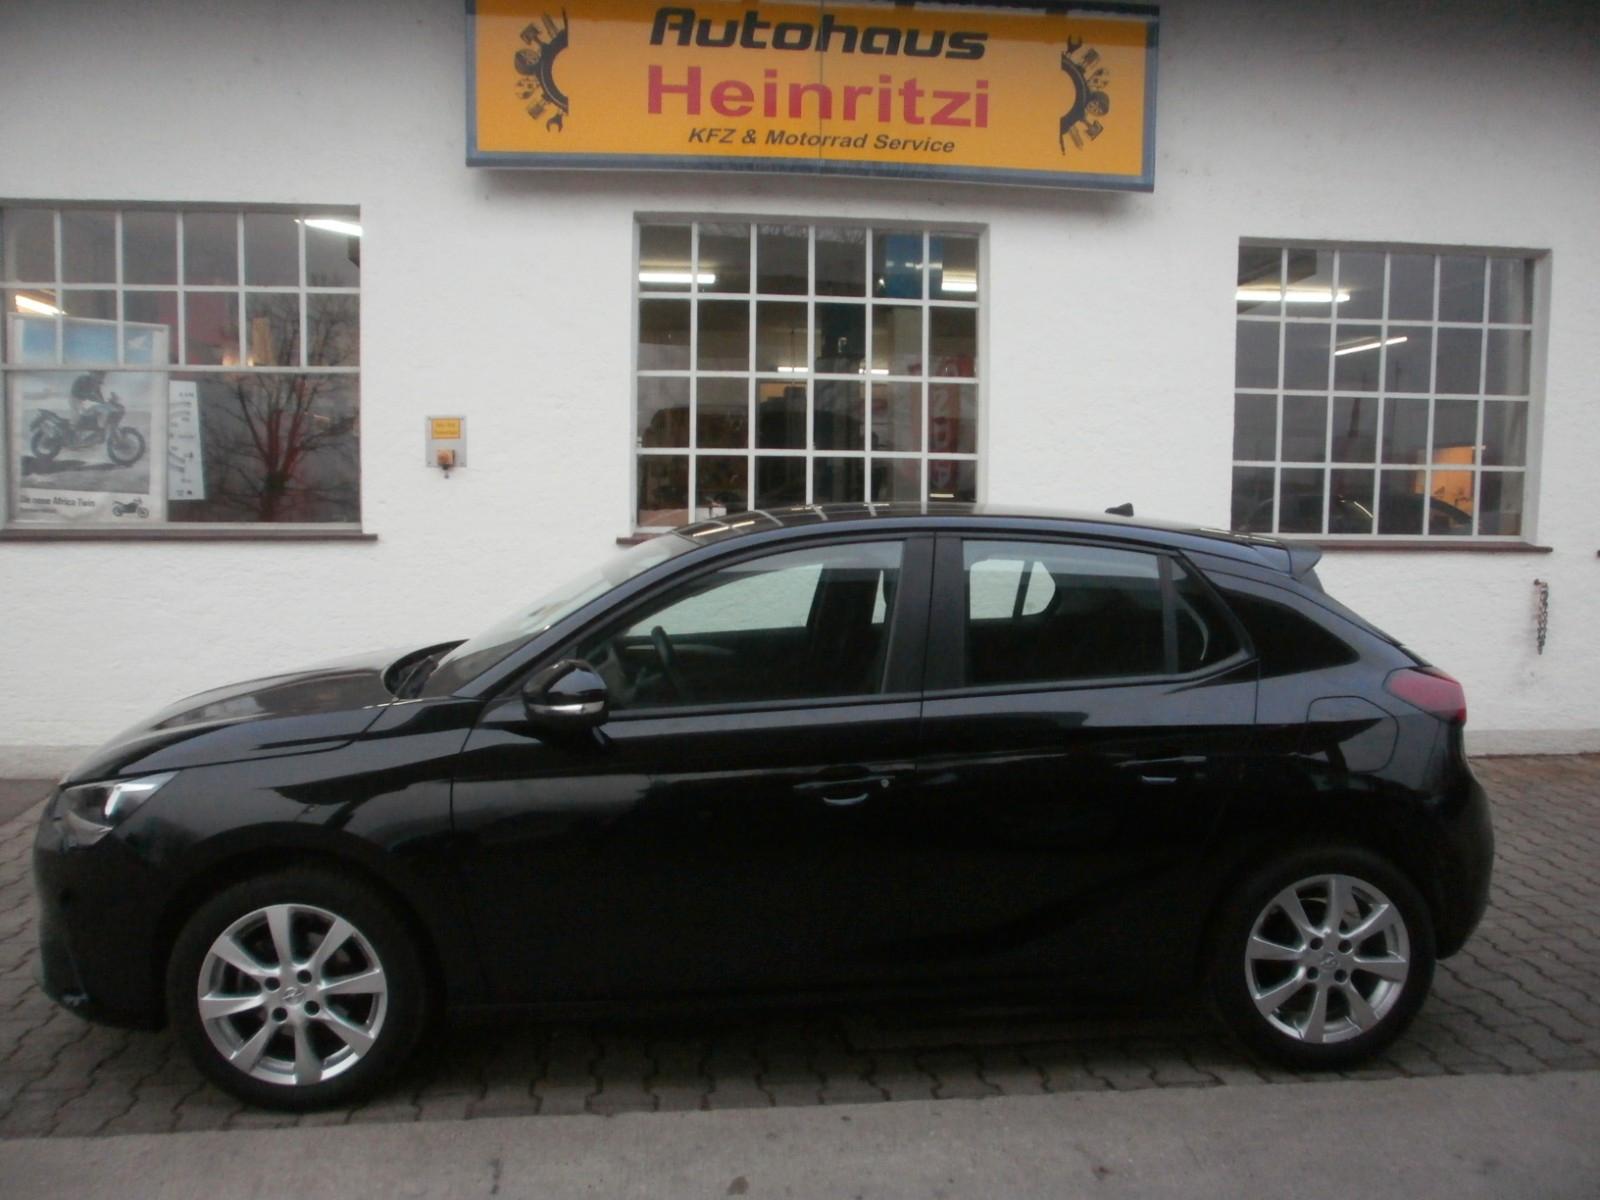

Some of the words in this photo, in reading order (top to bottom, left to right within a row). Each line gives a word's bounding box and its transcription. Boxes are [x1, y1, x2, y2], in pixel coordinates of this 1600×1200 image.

[650, 7, 988, 60] Autohaus
[648, 64, 989, 128] Heinritzi
[688, 127, 737, 144] KFZ
[742, 129, 757, 145] &
[765, 131, 867, 149] Motorrad
[873, 134, 956, 154] Service
